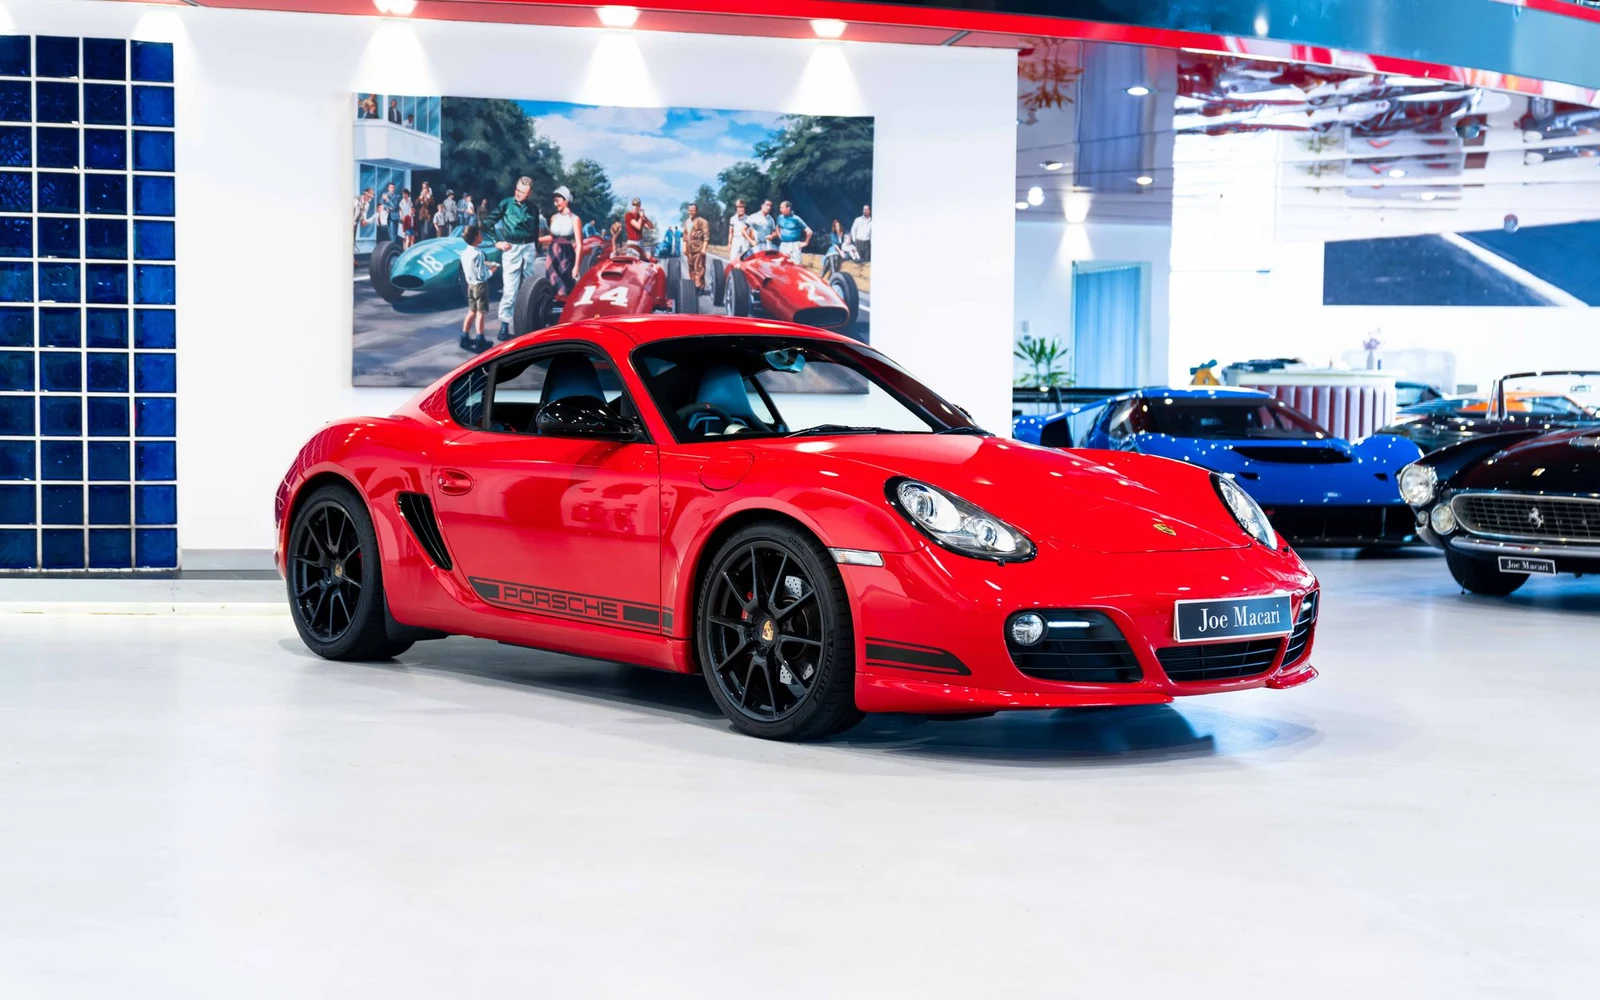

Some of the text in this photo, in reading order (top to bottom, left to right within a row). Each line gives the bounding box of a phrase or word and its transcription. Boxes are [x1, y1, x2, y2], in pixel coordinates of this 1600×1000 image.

[417, 255, 444, 274] 18
[573, 285, 629, 307] 14
[1506, 560, 1549, 572] Joe Macari
[503, 586, 618, 619] PORSCHE
[1198, 603, 1281, 632] Joe Macari
